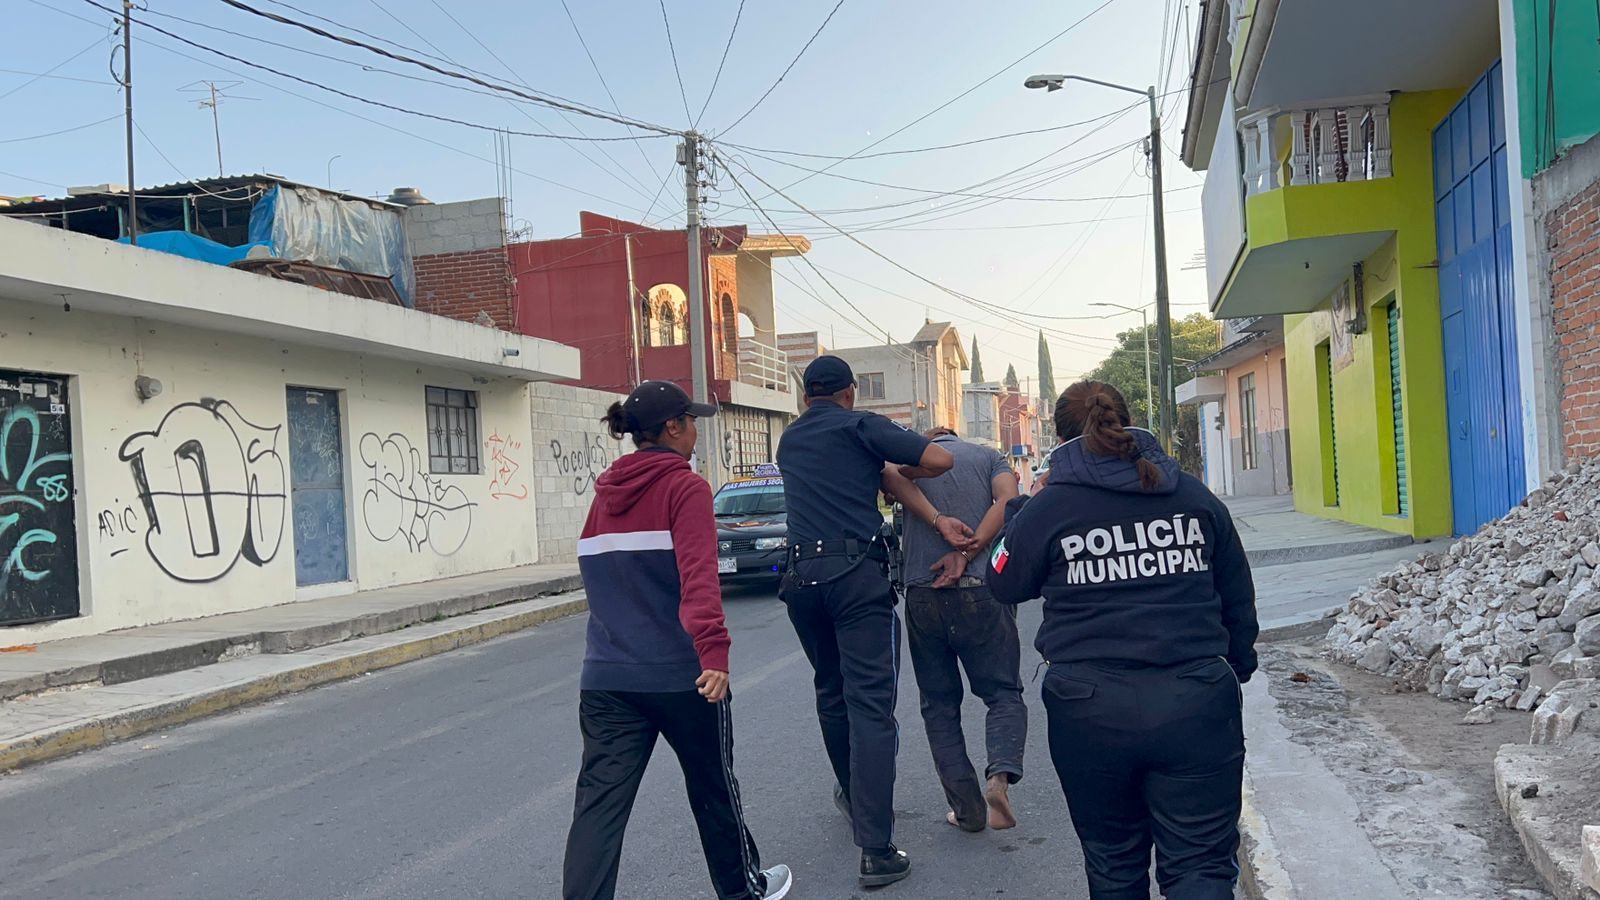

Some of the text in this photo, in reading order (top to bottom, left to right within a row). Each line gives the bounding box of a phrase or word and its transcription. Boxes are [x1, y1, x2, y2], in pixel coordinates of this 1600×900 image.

[51, 404, 64, 413] 54
[738, 480, 767, 488] MUJERES
[1060, 513, 1205, 561] POLICÍA
[1067, 548, 1208, 584] MUNICIPAL
